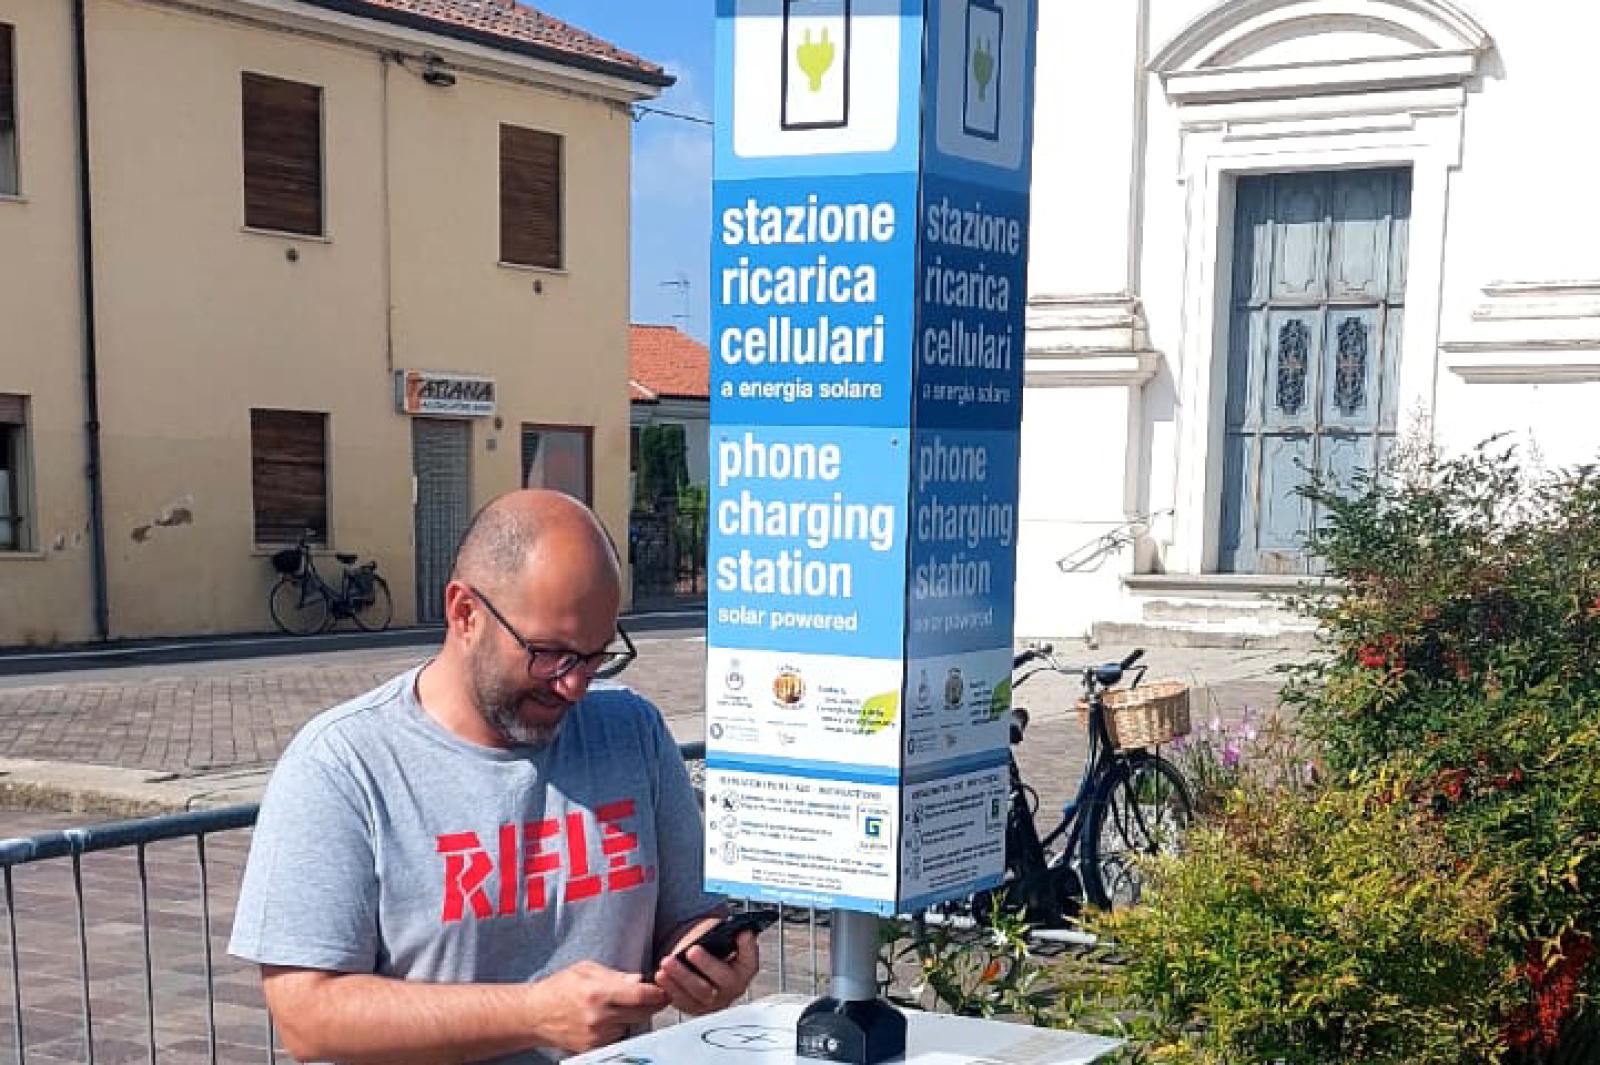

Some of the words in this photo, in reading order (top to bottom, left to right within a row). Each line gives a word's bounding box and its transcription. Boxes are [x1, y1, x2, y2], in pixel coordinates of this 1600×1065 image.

[722, 193, 895, 245] stazione
[927, 197, 1019, 256] stazione
[721, 255, 876, 305] ricarica
[924, 255, 1009, 312] ricarica
[720, 315, 884, 365] cellulari
[924, 319, 1012, 369] cellulari
[720, 380, 733, 397] a
[739, 377, 813, 402] energia
[819, 377, 882, 399] solare
[719, 432, 841, 487] phone
[919, 434, 988, 492] phone
[717, 490, 895, 551] charging
[918, 495, 1013, 549] charging
[716, 549, 852, 598] station
[915, 552, 991, 600] station
[718, 605, 766, 625] solar
[771, 609, 858, 632] powered
